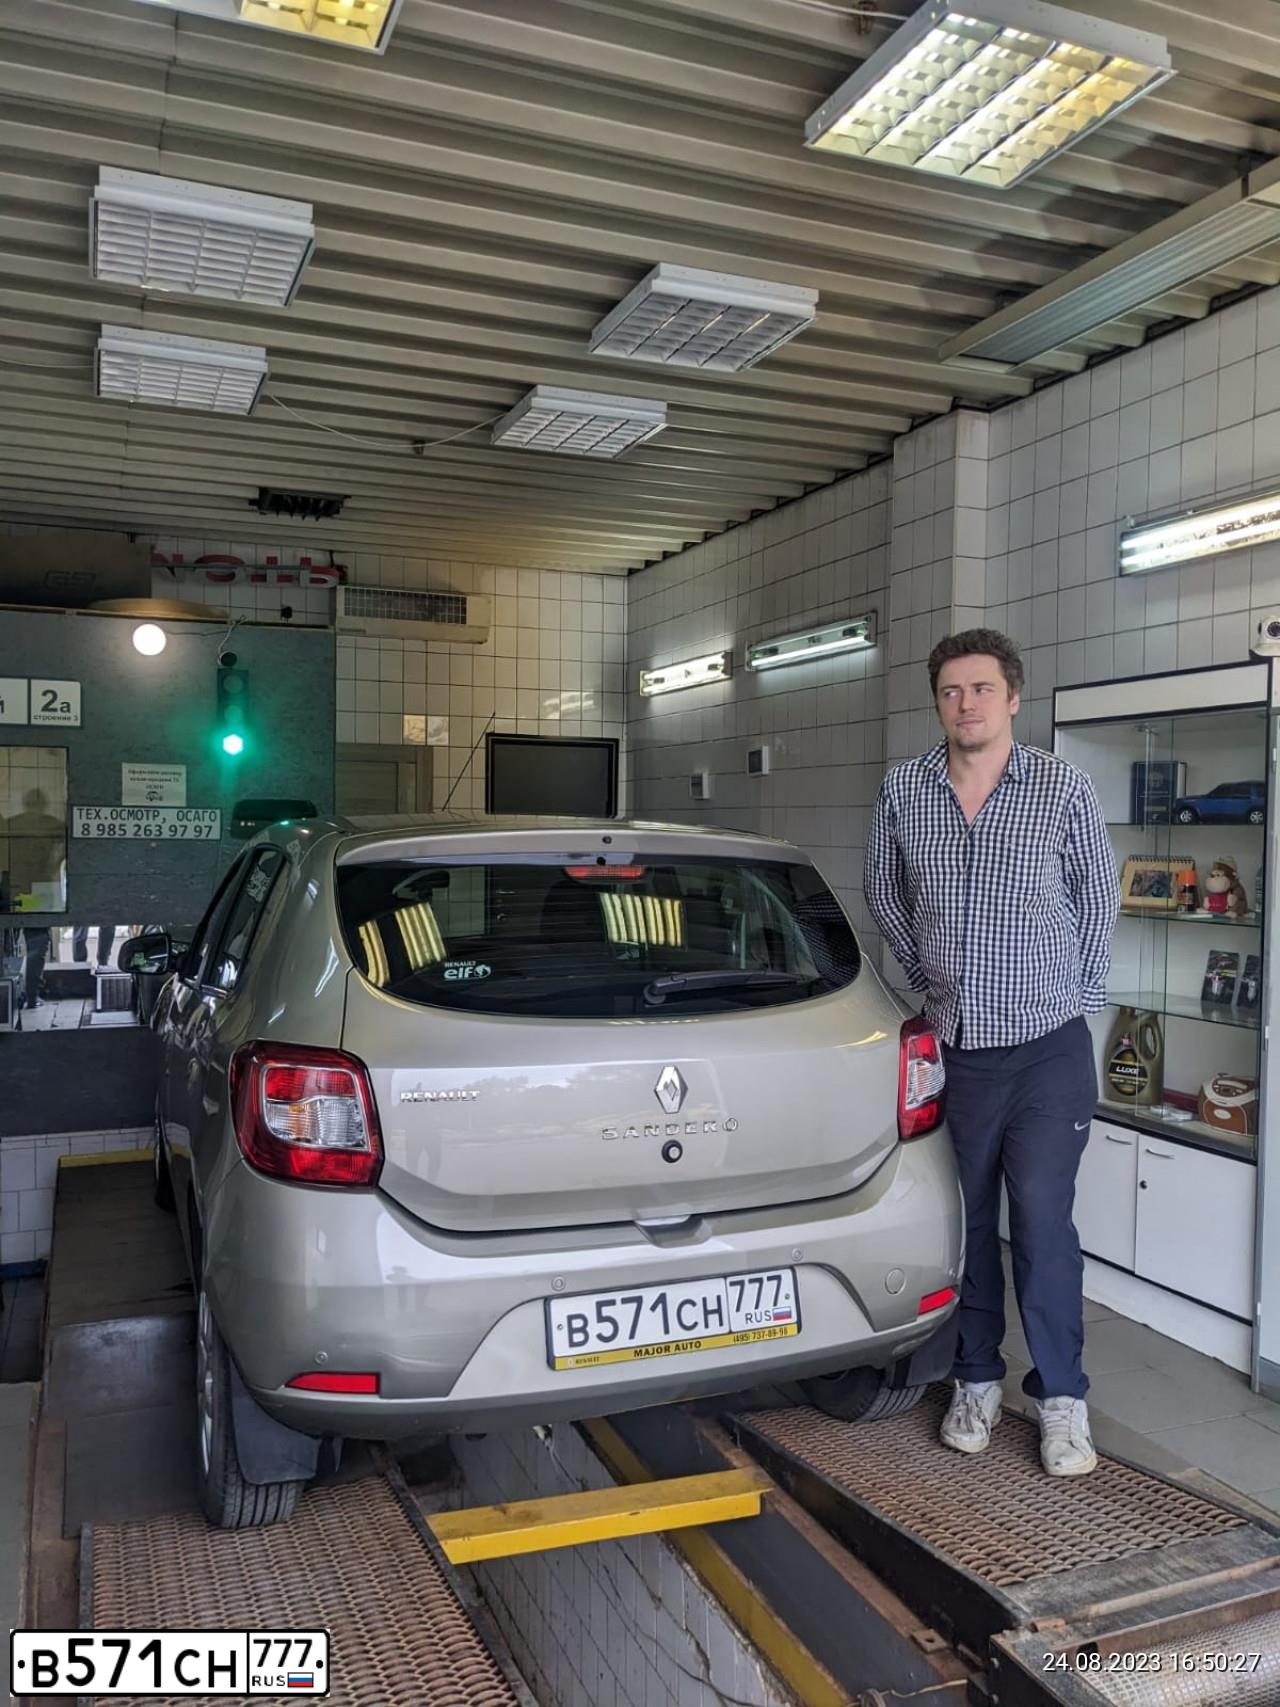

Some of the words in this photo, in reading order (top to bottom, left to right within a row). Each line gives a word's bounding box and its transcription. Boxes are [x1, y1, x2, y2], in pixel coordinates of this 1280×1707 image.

[41, 689, 71, 713] 2а
[77, 808, 166, 824] ТЕХ.ОСМОТР,
[176, 810, 217, 823] ОСАГО
[81, 823, 91, 836] 8
[96, 823, 127, 837] 985
[133, 824, 163, 837] 263
[168, 824, 188, 838] 97
[193, 825, 213, 838] 97
[1116, 1065, 1140, 1075] LUXE
[400, 1091, 480, 1103] RENAULT
[601, 1117, 739, 1141] SANDERO
[566, 1292, 724, 1348] В571СН
[729, 1274, 782, 1312] 777
[745, 1310, 772, 1325] RUS
[633, 1344, 671, 1358] MAJOR
[674, 1340, 703, 1352] AUTO
